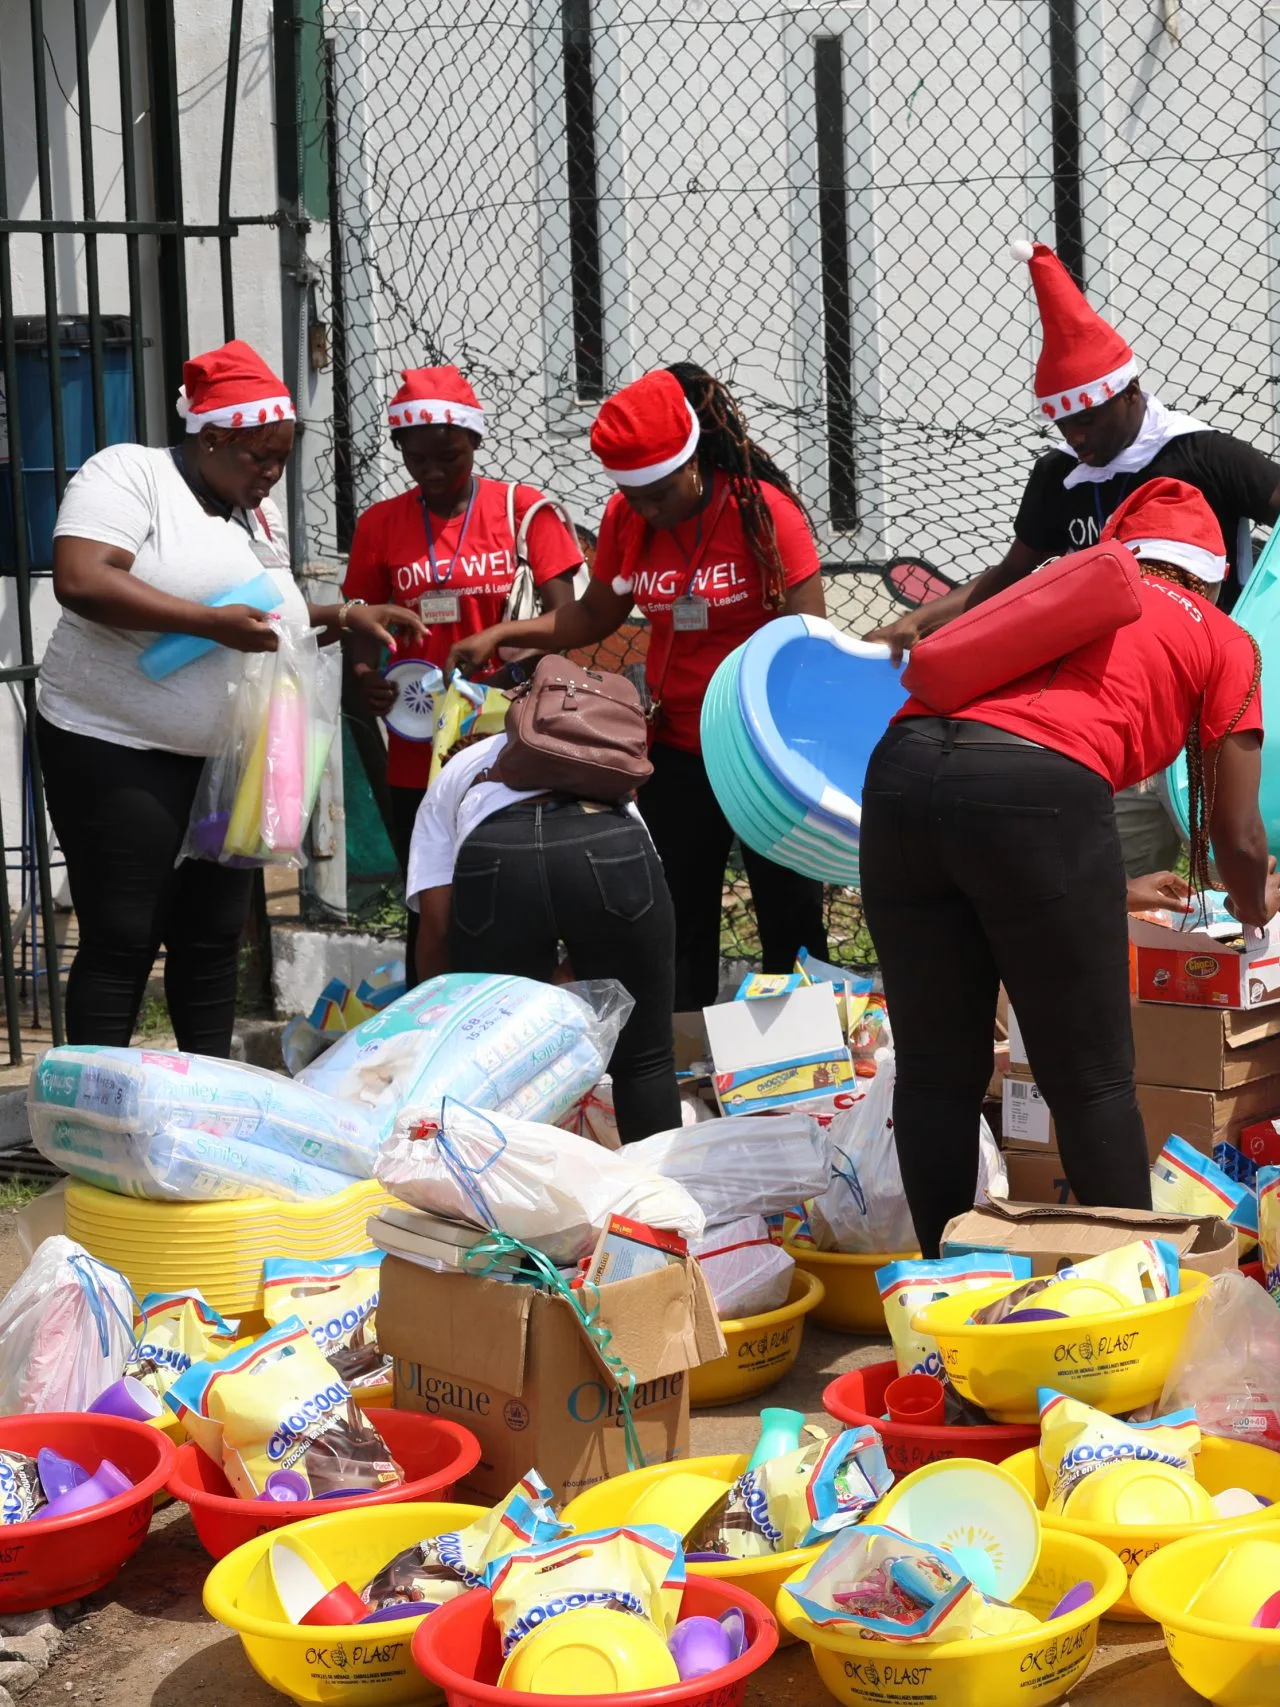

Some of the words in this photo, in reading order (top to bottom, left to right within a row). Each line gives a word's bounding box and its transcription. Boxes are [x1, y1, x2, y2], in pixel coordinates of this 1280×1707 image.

[1068, 516, 1113, 546] ON
[461, 550, 514, 577] WEL
[713, 590, 748, 607] Leaders
[196, 1138, 248, 1168] Smiley
[738, 1342, 759, 1358] OK
[1054, 1343, 1079, 1363] OK
[1098, 1332, 1139, 1356] PLAST
[374, 1462, 393, 1470] Punch
[1081, 1465, 1093, 1475] en
[305, 1648, 331, 1669] OK
[353, 1643, 404, 1665] PLAST
[1021, 1649, 1044, 1673] OK
[1060, 1624, 1091, 1659] PLAST
[844, 1661, 866, 1685] OK
[884, 1666, 932, 1685] PLAST
